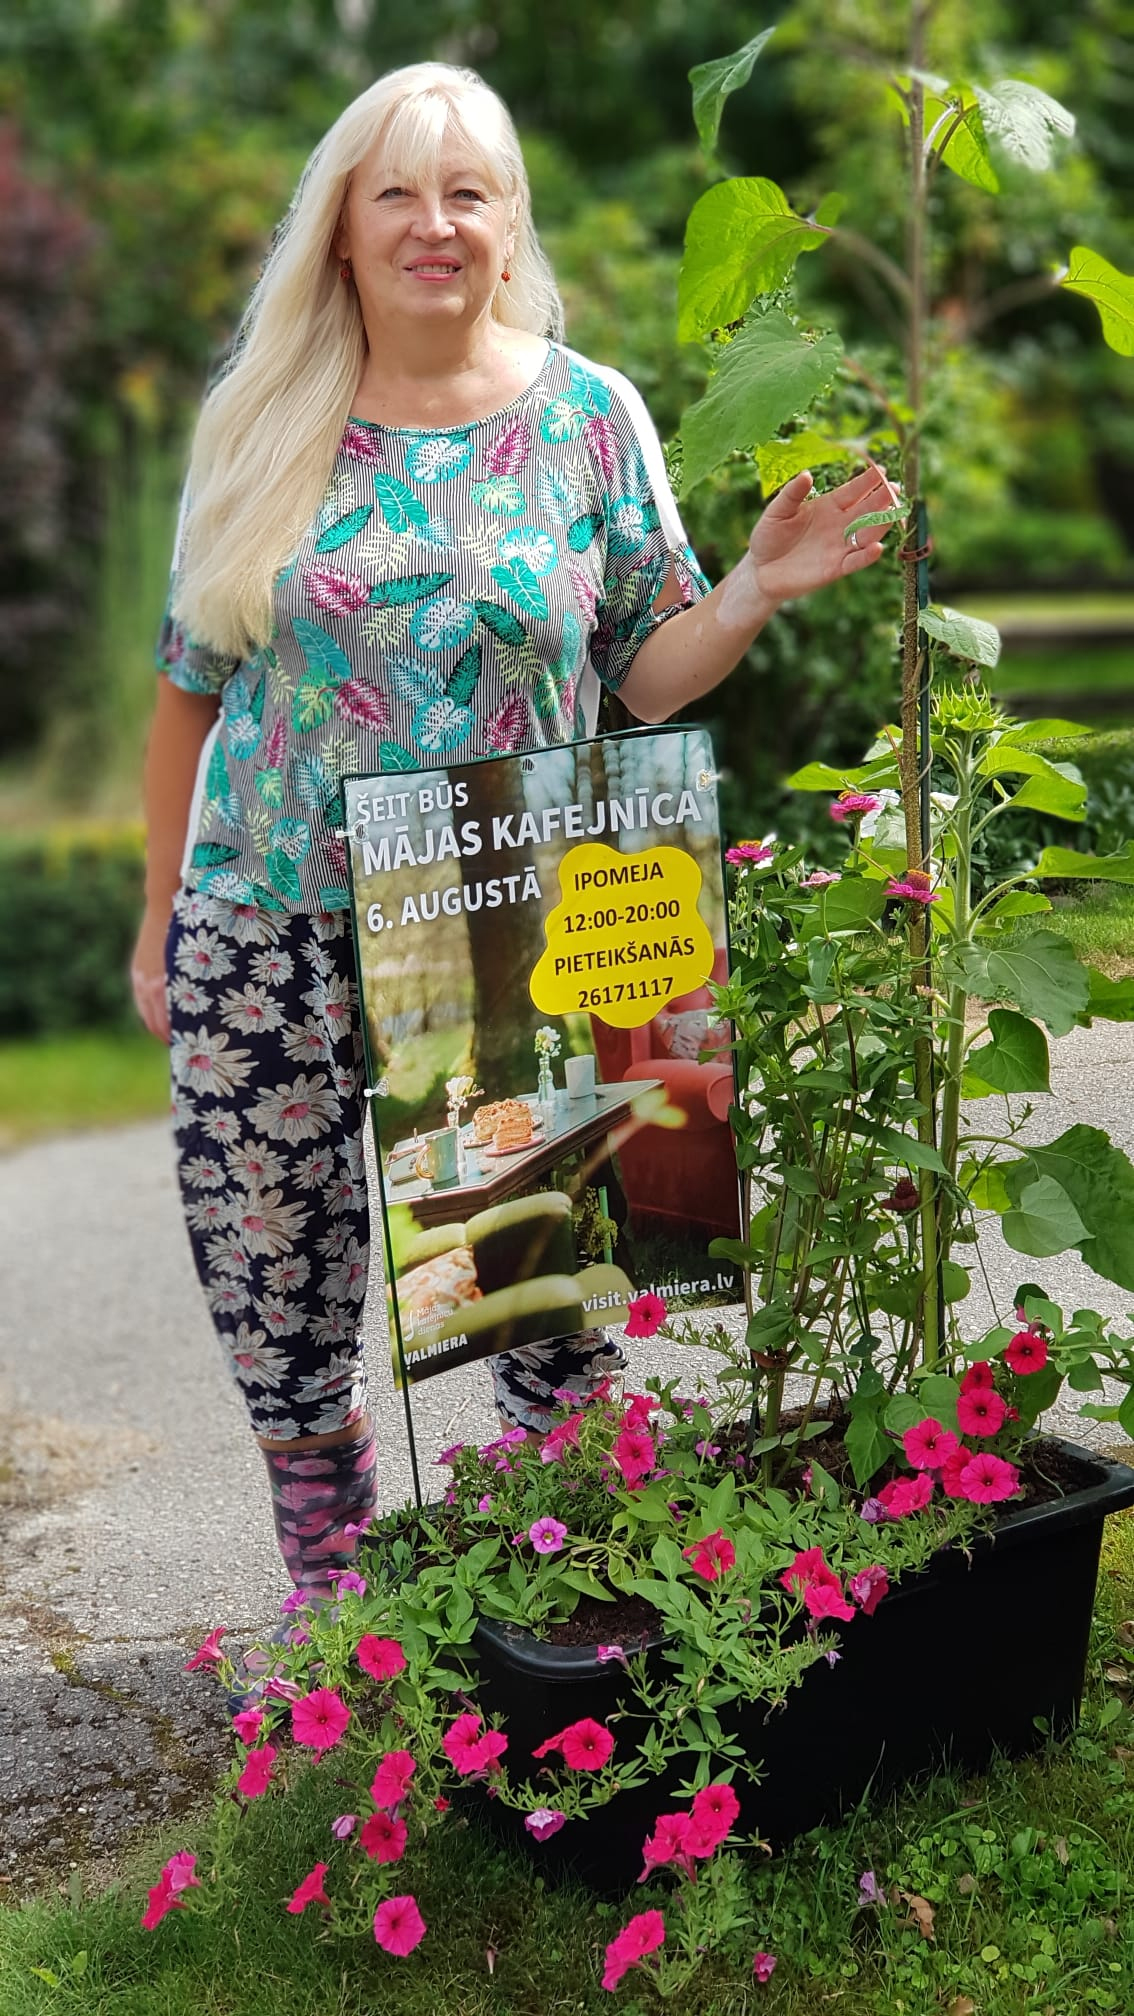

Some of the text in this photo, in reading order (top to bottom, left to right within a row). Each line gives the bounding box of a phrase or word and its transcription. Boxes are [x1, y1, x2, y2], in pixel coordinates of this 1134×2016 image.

[356, 781, 469, 824] ŠEIT BŪS
[362, 787, 702, 876] MĀJAS KAFEJNĪCA
[574, 862, 664, 891] IPOMEJA
[367, 866, 542, 932] 6. AUGUSTĀ
[563, 900, 680, 934] 12:00-20:00
[555, 936, 695, 976] PIETEIKŠANĀS
[578, 977, 674, 1008] 26171117
[404, 1333, 468, 1366] VALMIERA
